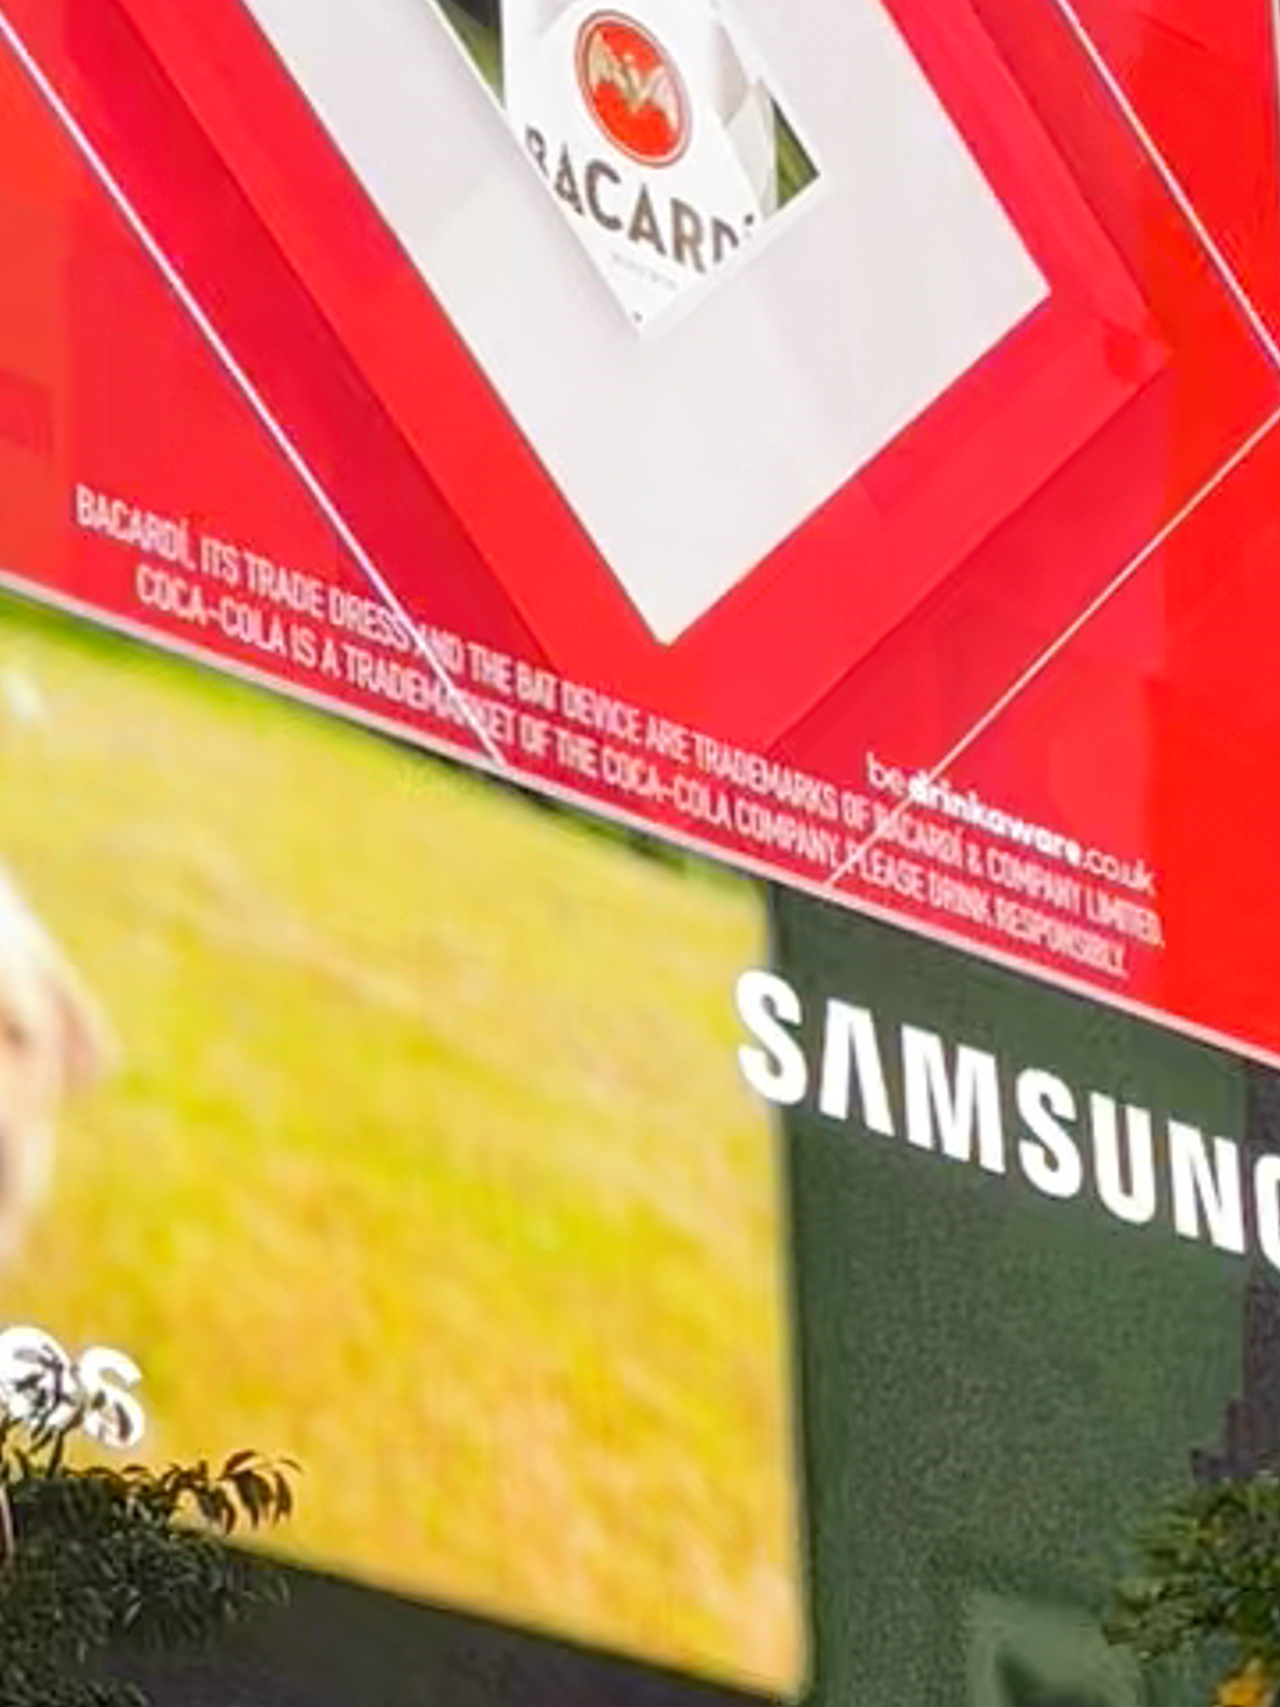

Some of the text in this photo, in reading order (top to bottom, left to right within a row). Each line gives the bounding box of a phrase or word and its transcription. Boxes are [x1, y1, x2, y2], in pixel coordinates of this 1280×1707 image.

[136, 562, 288, 663] COCA-COLA
[290, 622, 318, 669] IS
[321, 635, 341, 679] A
[519, 711, 550, 759] OF
[552, 727, 601, 781] THE
[601, 743, 733, 831] COCA-COLA
[844, 835, 925, 902] PLEASE
[927, 868, 993, 929] DRINK
[200, 535, 239, 587] ITS
[245, 550, 324, 619] TRADE
[329, 587, 414, 657] DRESS
[417, 623, 466, 674] AND
[468, 640, 513, 693] THE
[516, 660, 559, 710] BAT
[561, 680, 640, 743] DEVICE
[645, 714, 689, 764] ARE
[691, 729, 838, 821] TRADEMARKS
[841, 790, 870, 832] OF
[967, 842, 983, 876] &
[986, 846, 1080, 915] COMPANY
